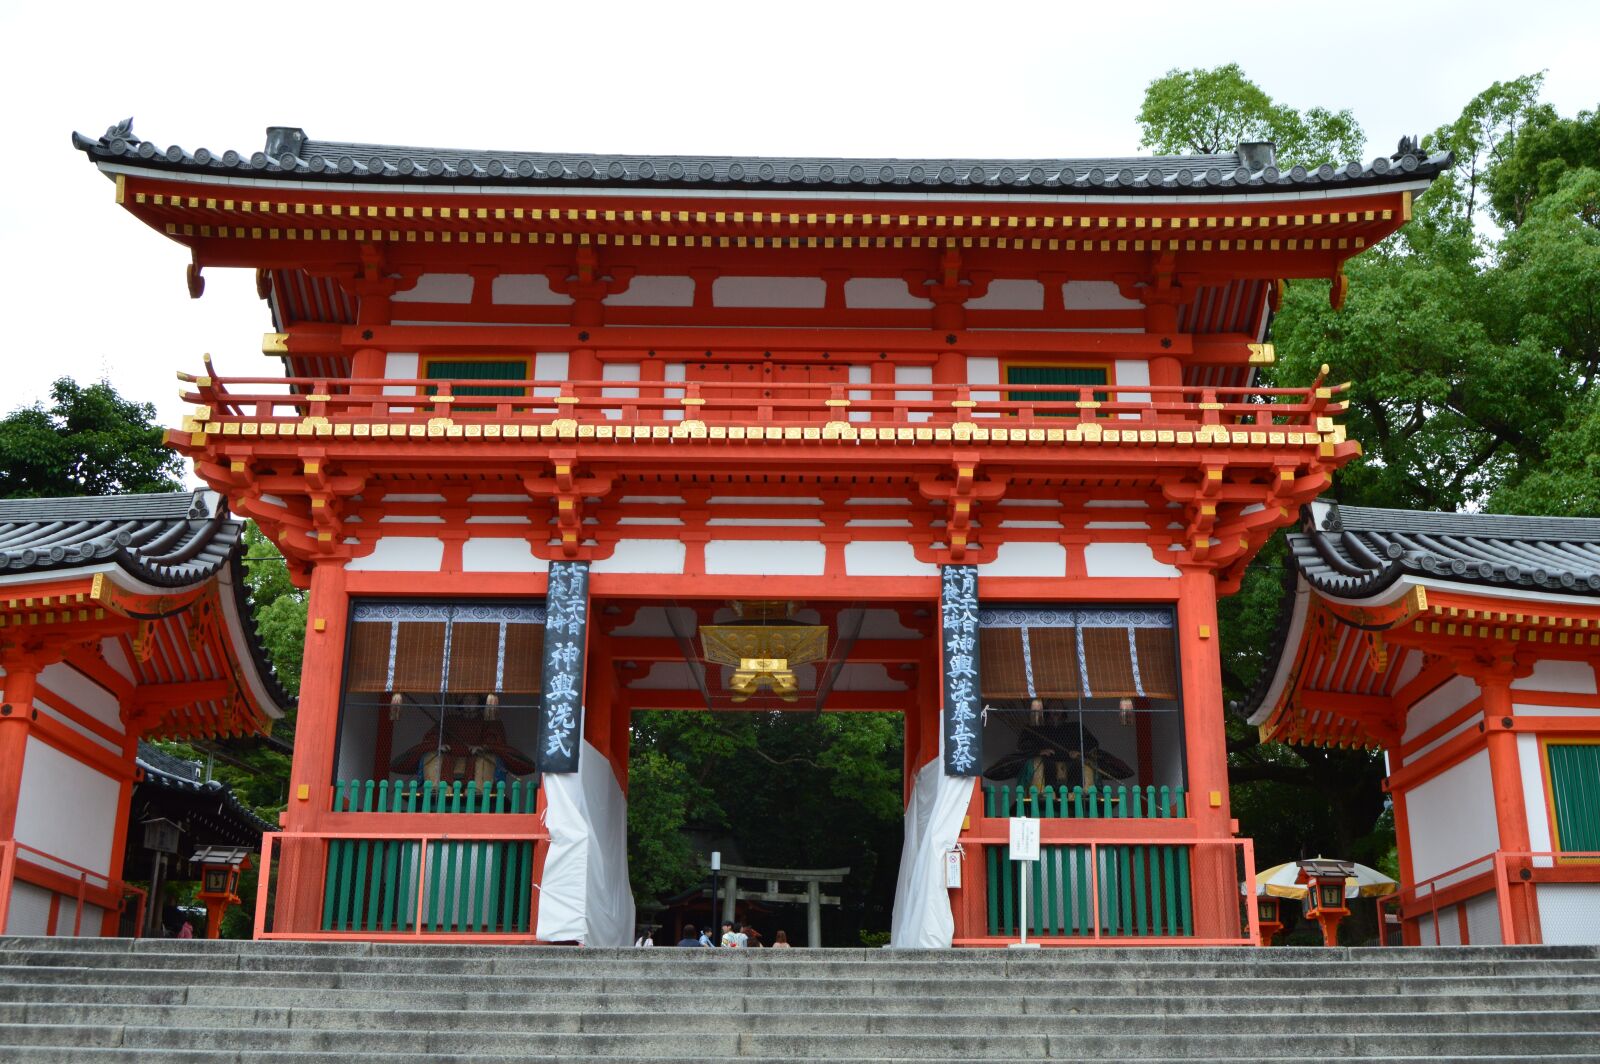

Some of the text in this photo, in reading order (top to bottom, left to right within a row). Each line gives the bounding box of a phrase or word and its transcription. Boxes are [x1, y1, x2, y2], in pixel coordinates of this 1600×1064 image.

[546, 562, 568, 634] 午後八時
[941, 565, 961, 634] 午後六時
[546, 641, 580, 758] 神輿洗式
